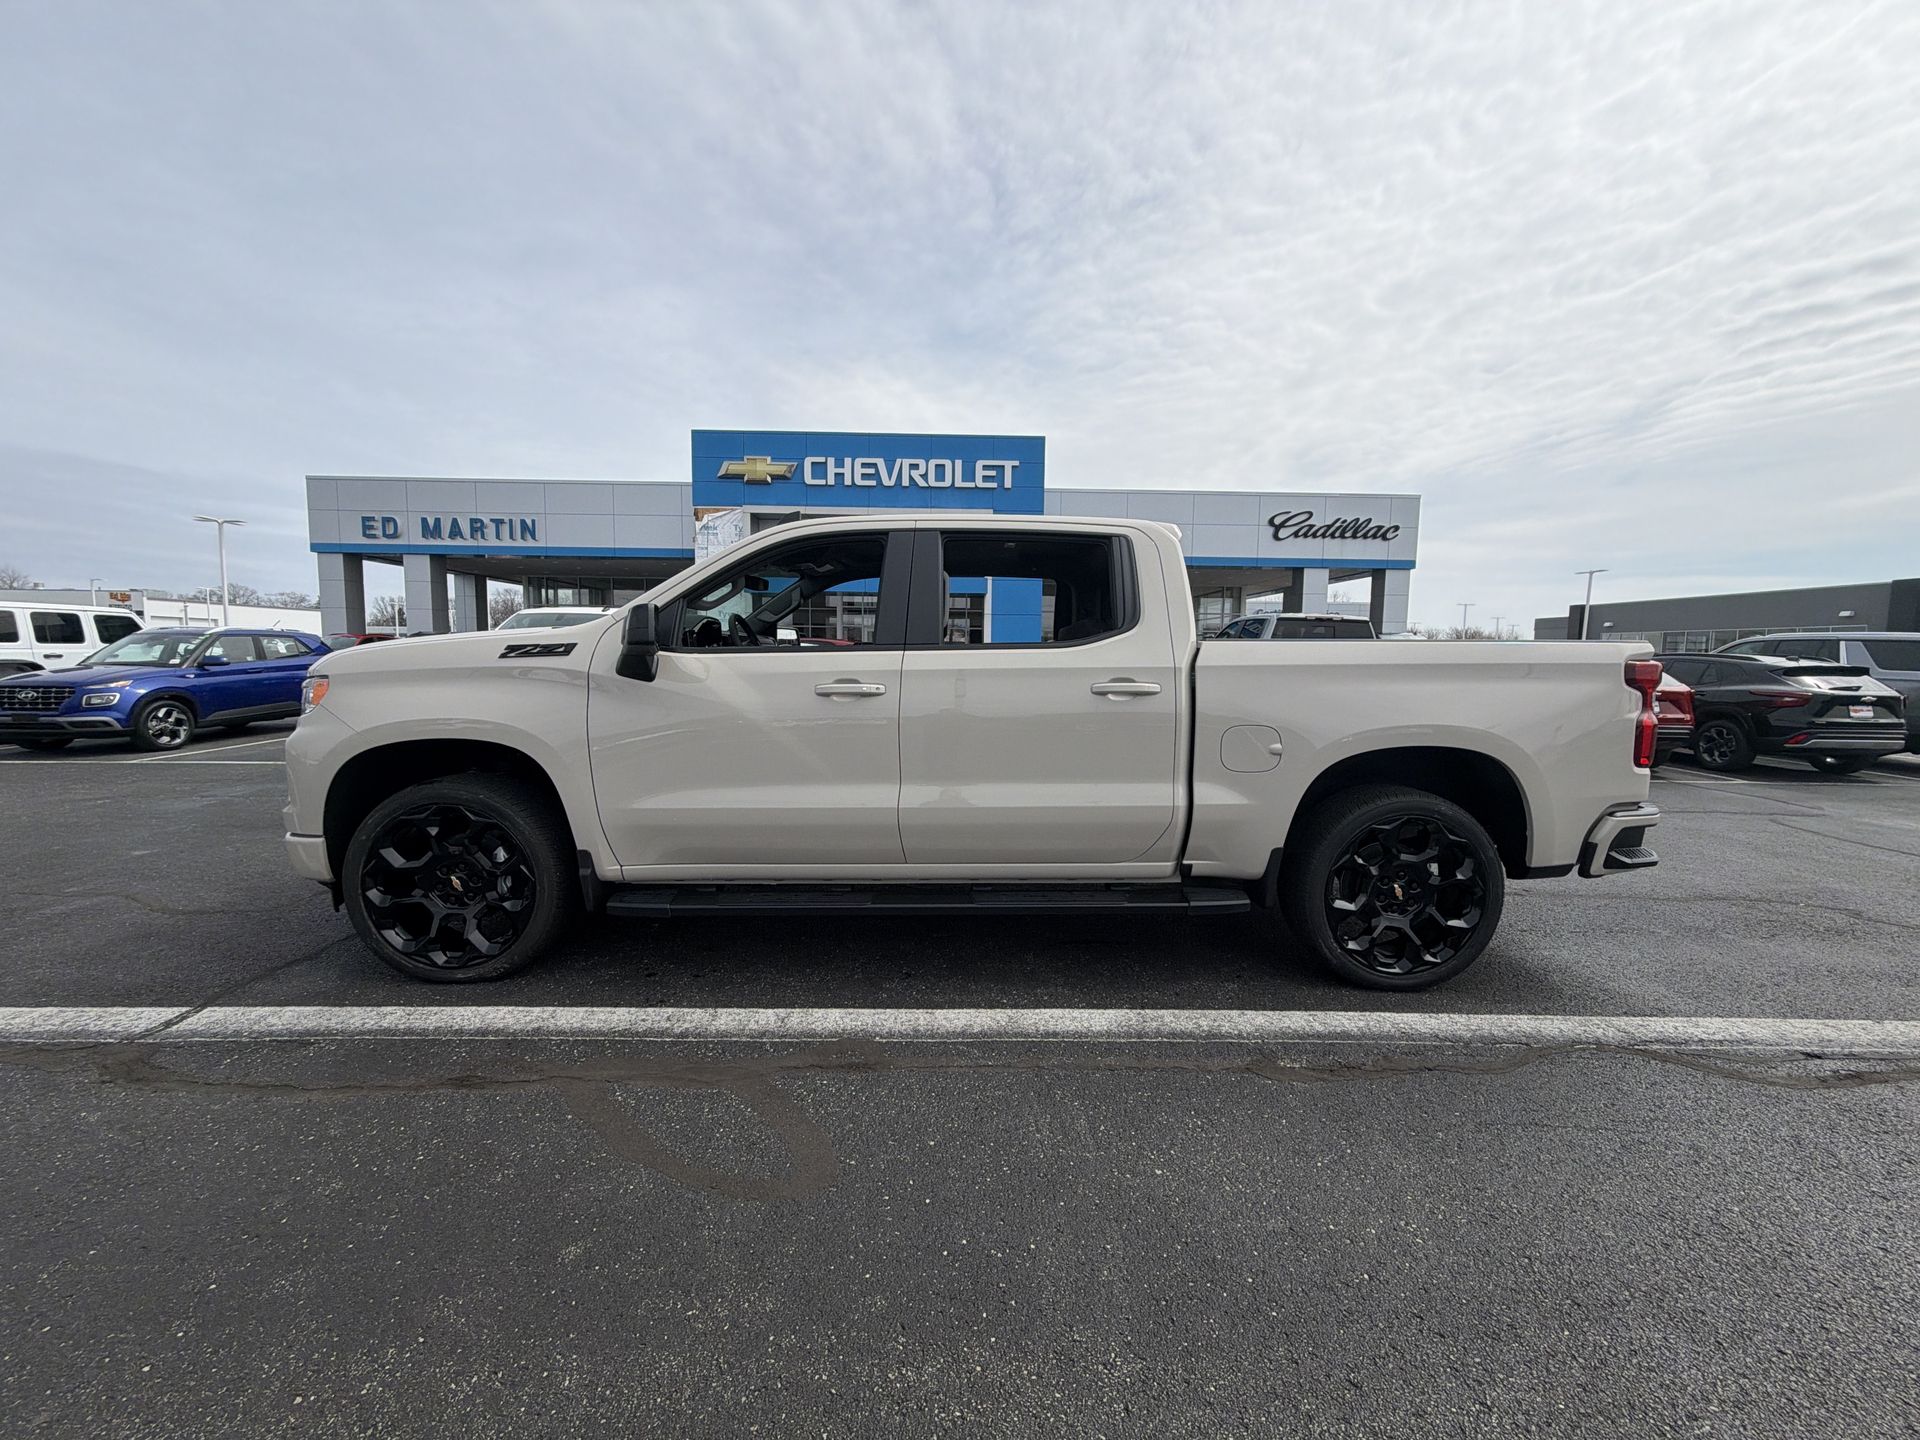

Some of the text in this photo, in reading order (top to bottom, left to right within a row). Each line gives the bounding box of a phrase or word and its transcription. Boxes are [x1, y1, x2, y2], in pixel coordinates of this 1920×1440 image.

[803, 456, 1020, 489] CHEVROLET
[360, 515, 538, 541] ED MARTIN
[1268, 510, 1401, 541] Cadillac
